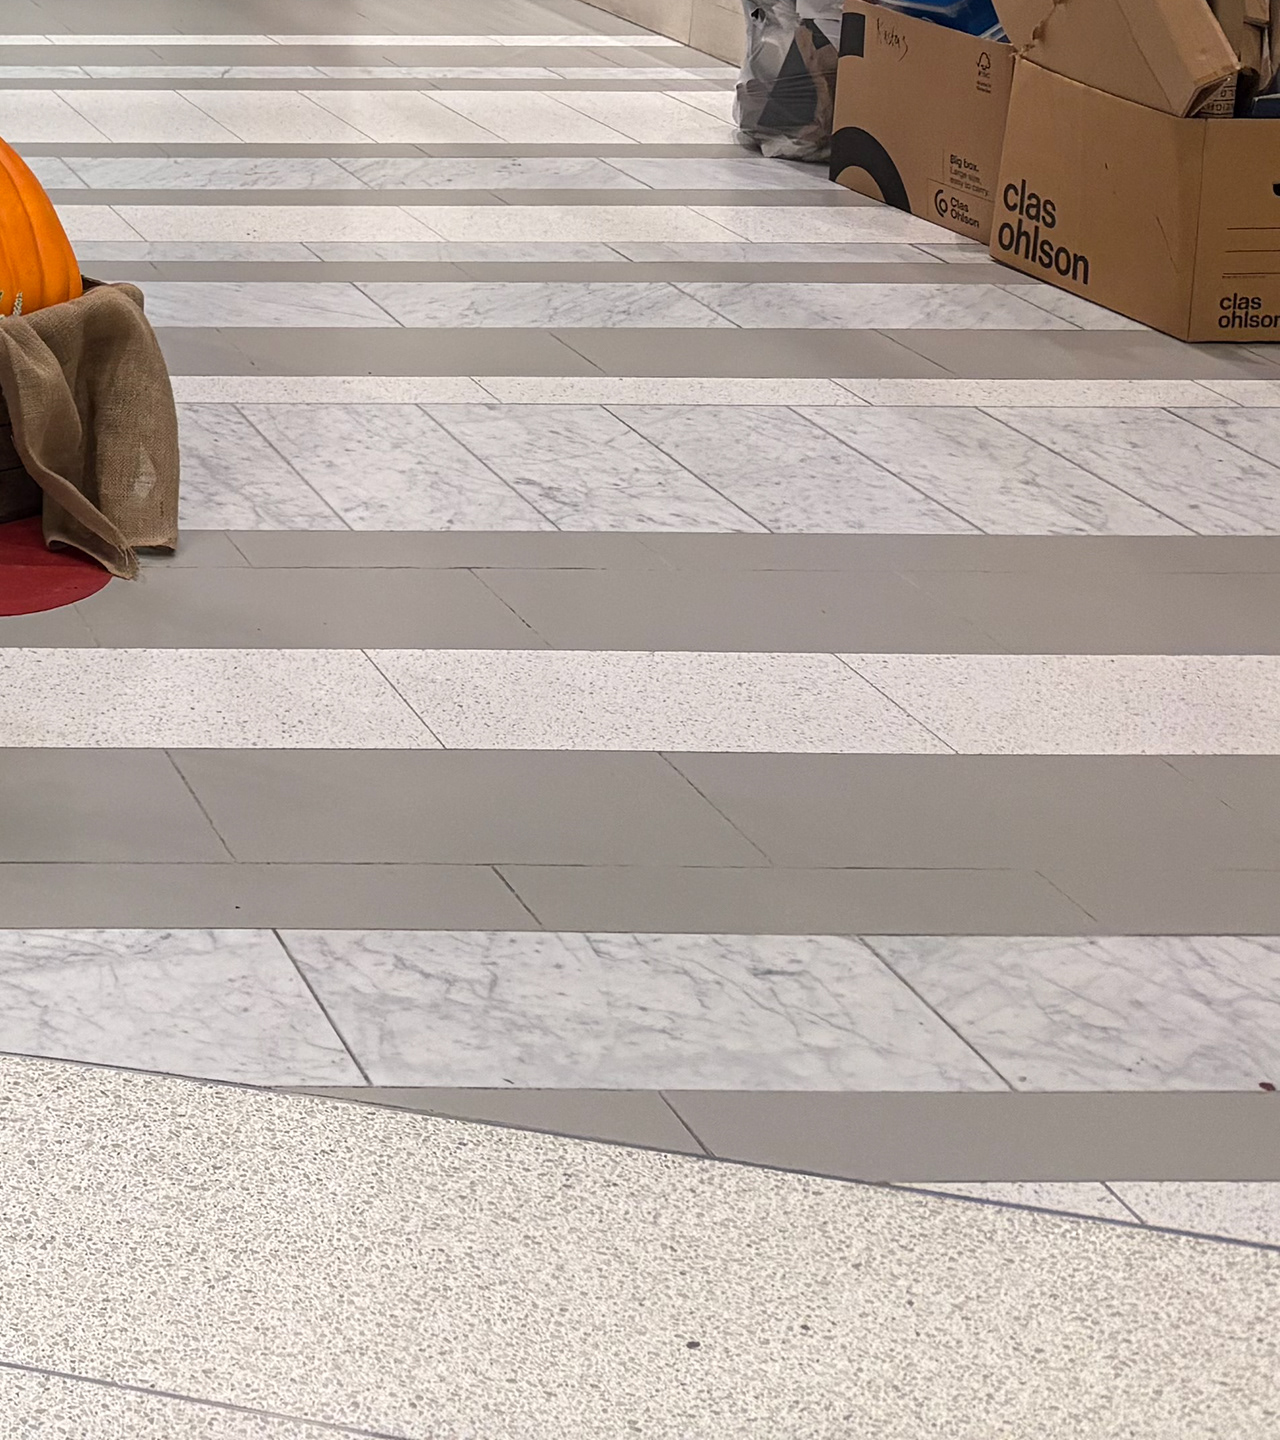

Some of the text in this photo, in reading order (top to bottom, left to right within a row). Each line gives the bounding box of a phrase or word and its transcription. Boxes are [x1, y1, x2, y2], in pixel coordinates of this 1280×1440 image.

[950, 154, 962, 169] Big
[950, 197, 969, 213] Clas
[1003, 179, 1056, 229] clas
[950, 208, 980, 228] Ohlson
[998, 218, 1089, 285] ohlson
[1219, 292, 1262, 310] clas
